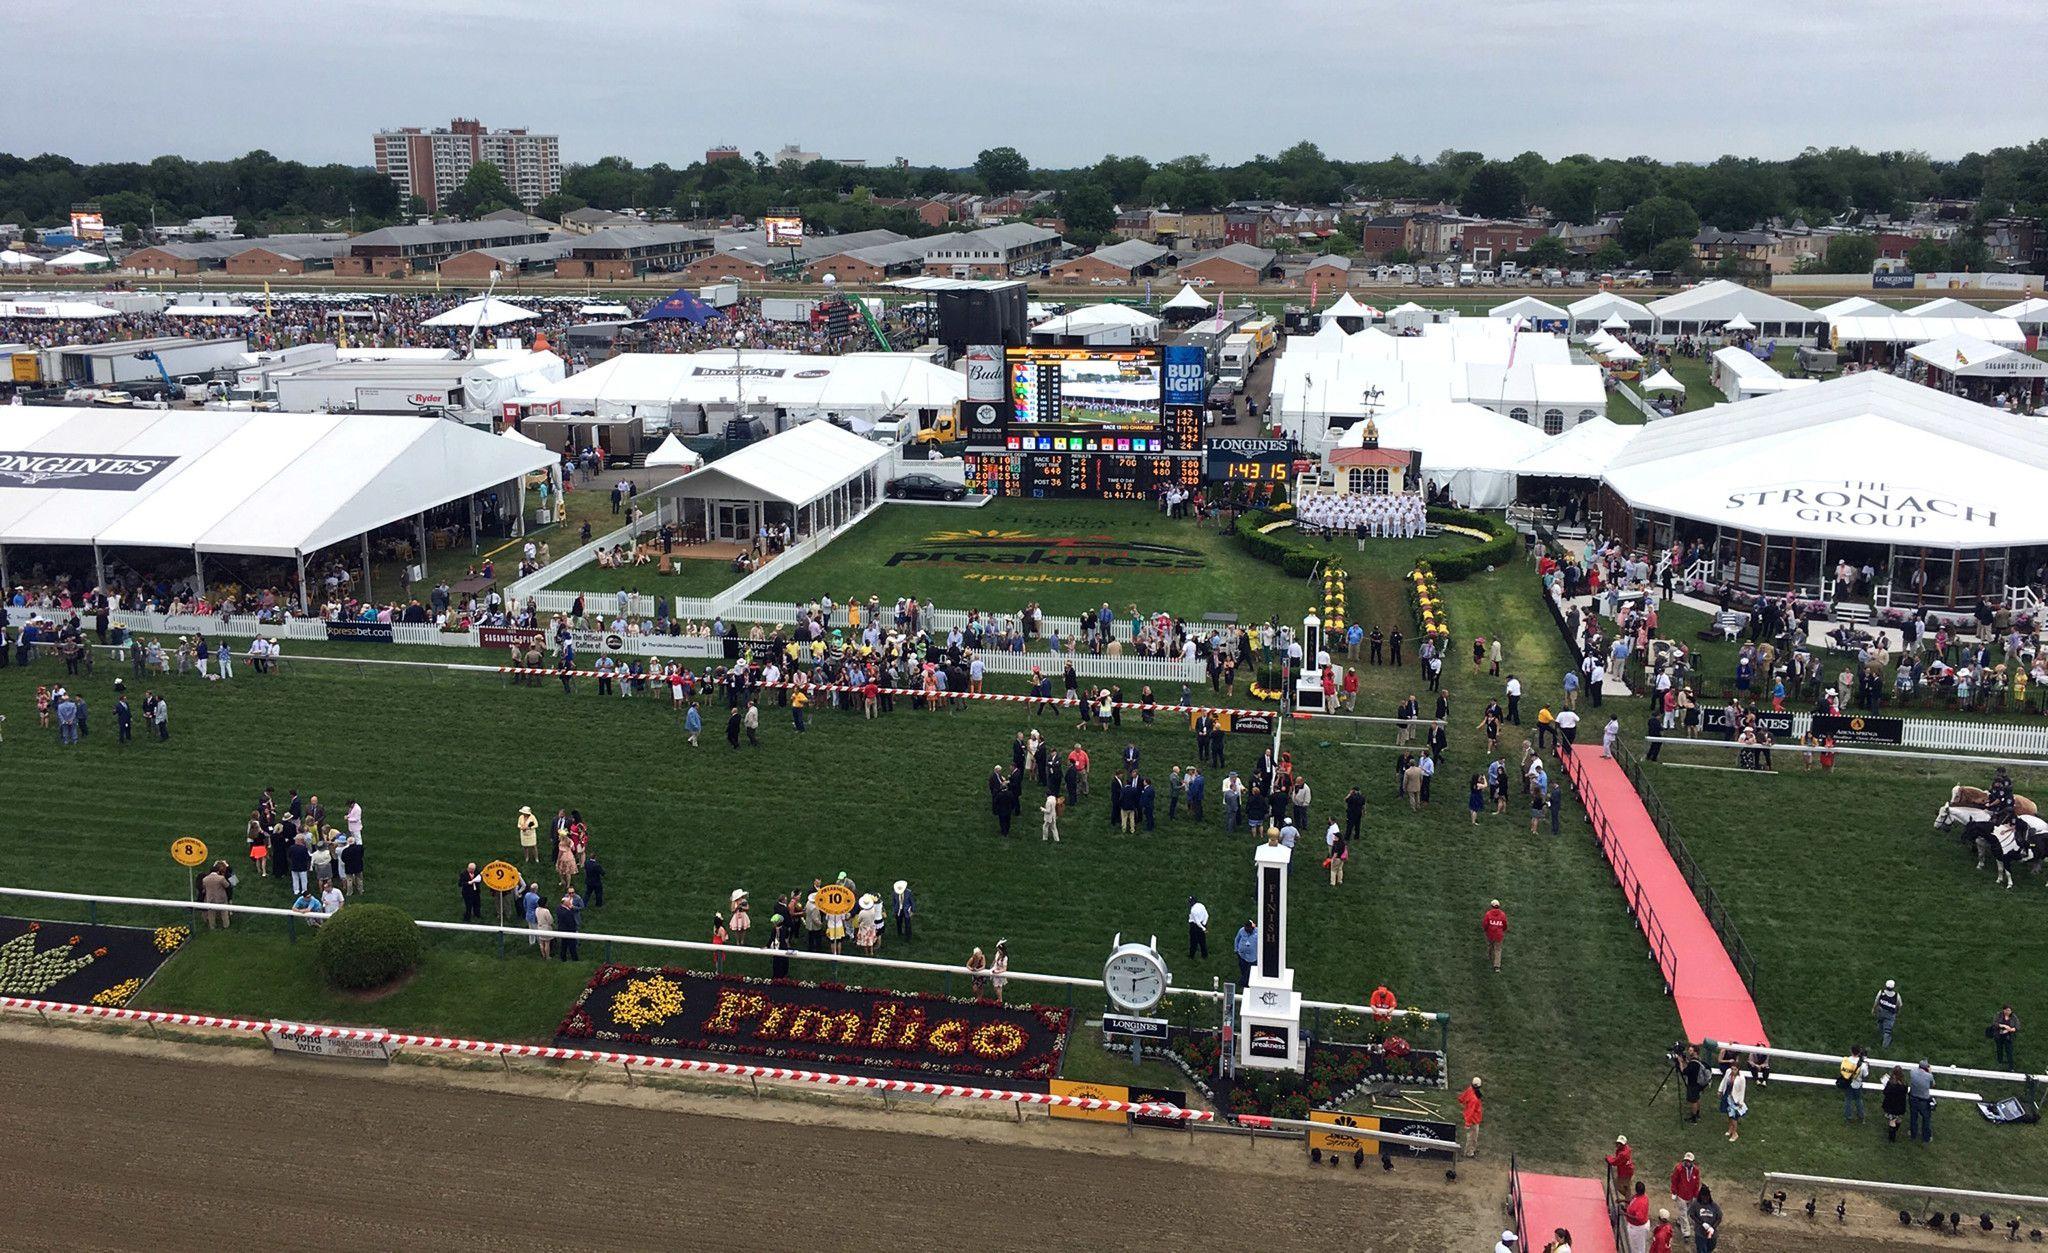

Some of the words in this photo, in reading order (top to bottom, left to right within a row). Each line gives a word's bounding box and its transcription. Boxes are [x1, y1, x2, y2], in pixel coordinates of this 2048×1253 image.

[1168, 364, 1201, 378] BUD
[1166, 378, 1203, 391] LIGHT
[415, 394, 442, 404] Ryder
[1212, 439, 1288, 451] LONGINES
[1845, 480, 1890, 492] THE
[1726, 488, 1997, 528] STRONACH
[1796, 508, 1927, 528] GROUP
[884, 550, 1206, 568] preakness
[963, 573, 1114, 584] #preakness
[1236, 722, 1268, 730] preakness
[185, 844, 193, 855] 8
[496, 869, 504, 880] 9
[828, 894, 842, 904] 10
[1267, 884, 1276, 943] FINISH
[703, 988, 1027, 1057] Pimlico
[1113, 1020, 1158, 1030] LONGINES
[297, 1043, 322, 1052] wire
[1251, 1041, 1286, 1051] preakness
[1325, 1138, 1362, 1148] Sports
